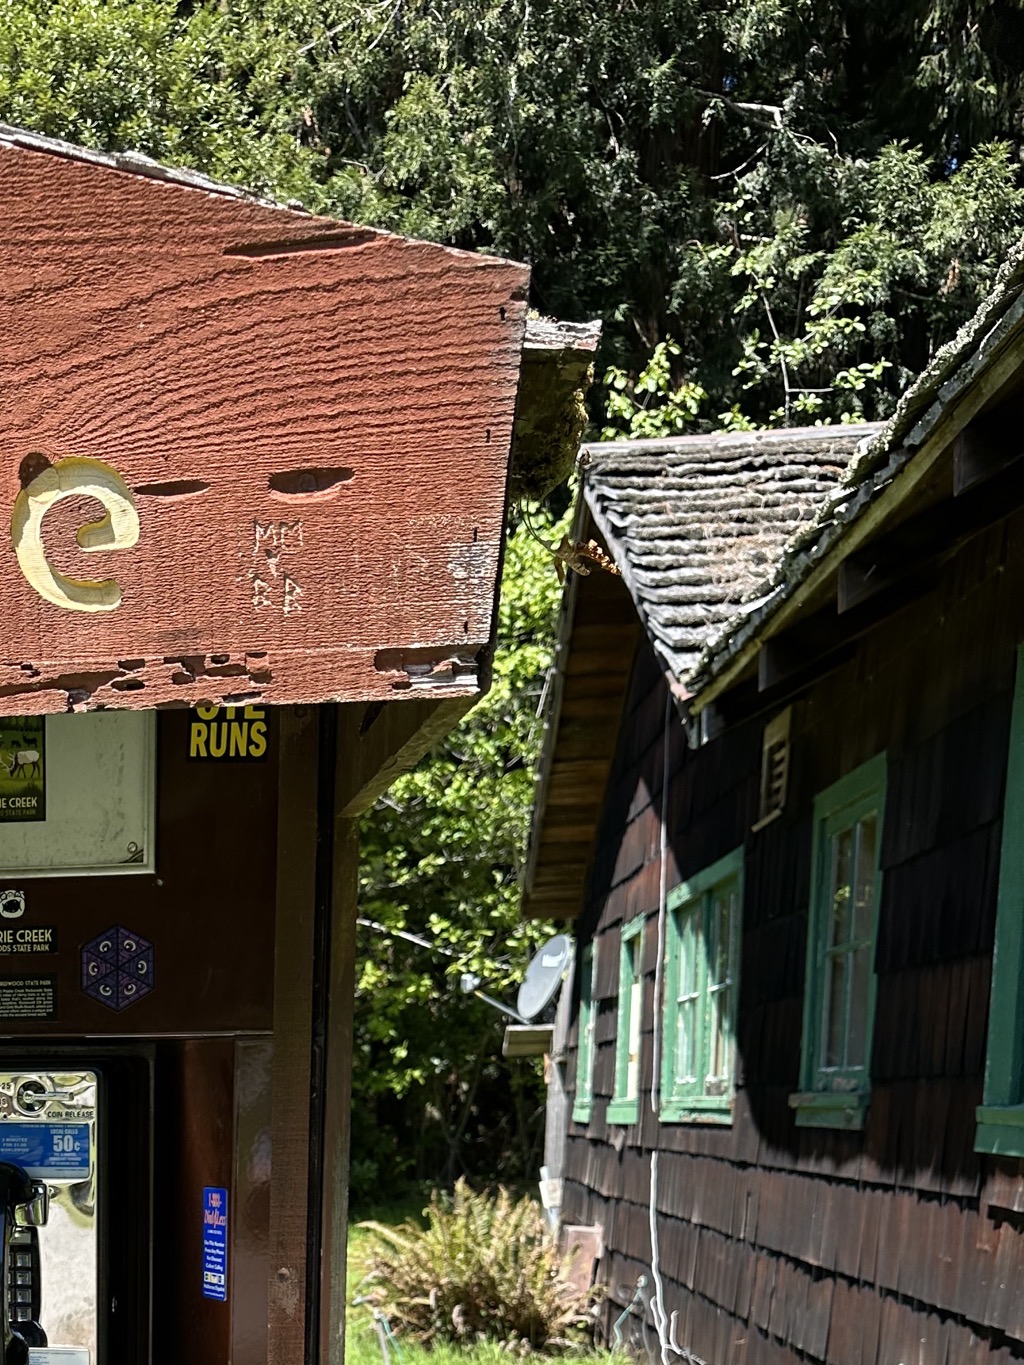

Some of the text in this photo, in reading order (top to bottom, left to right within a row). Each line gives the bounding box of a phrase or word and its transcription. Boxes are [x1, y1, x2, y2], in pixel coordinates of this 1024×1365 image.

[190, 721, 267, 757] RUNS
[9, 796, 38, 808] CREEK
[16, 929, 52, 942] CREEK
[13, 944, 31, 952] STATE
[53, 1135, 80, 1152] 50¢
